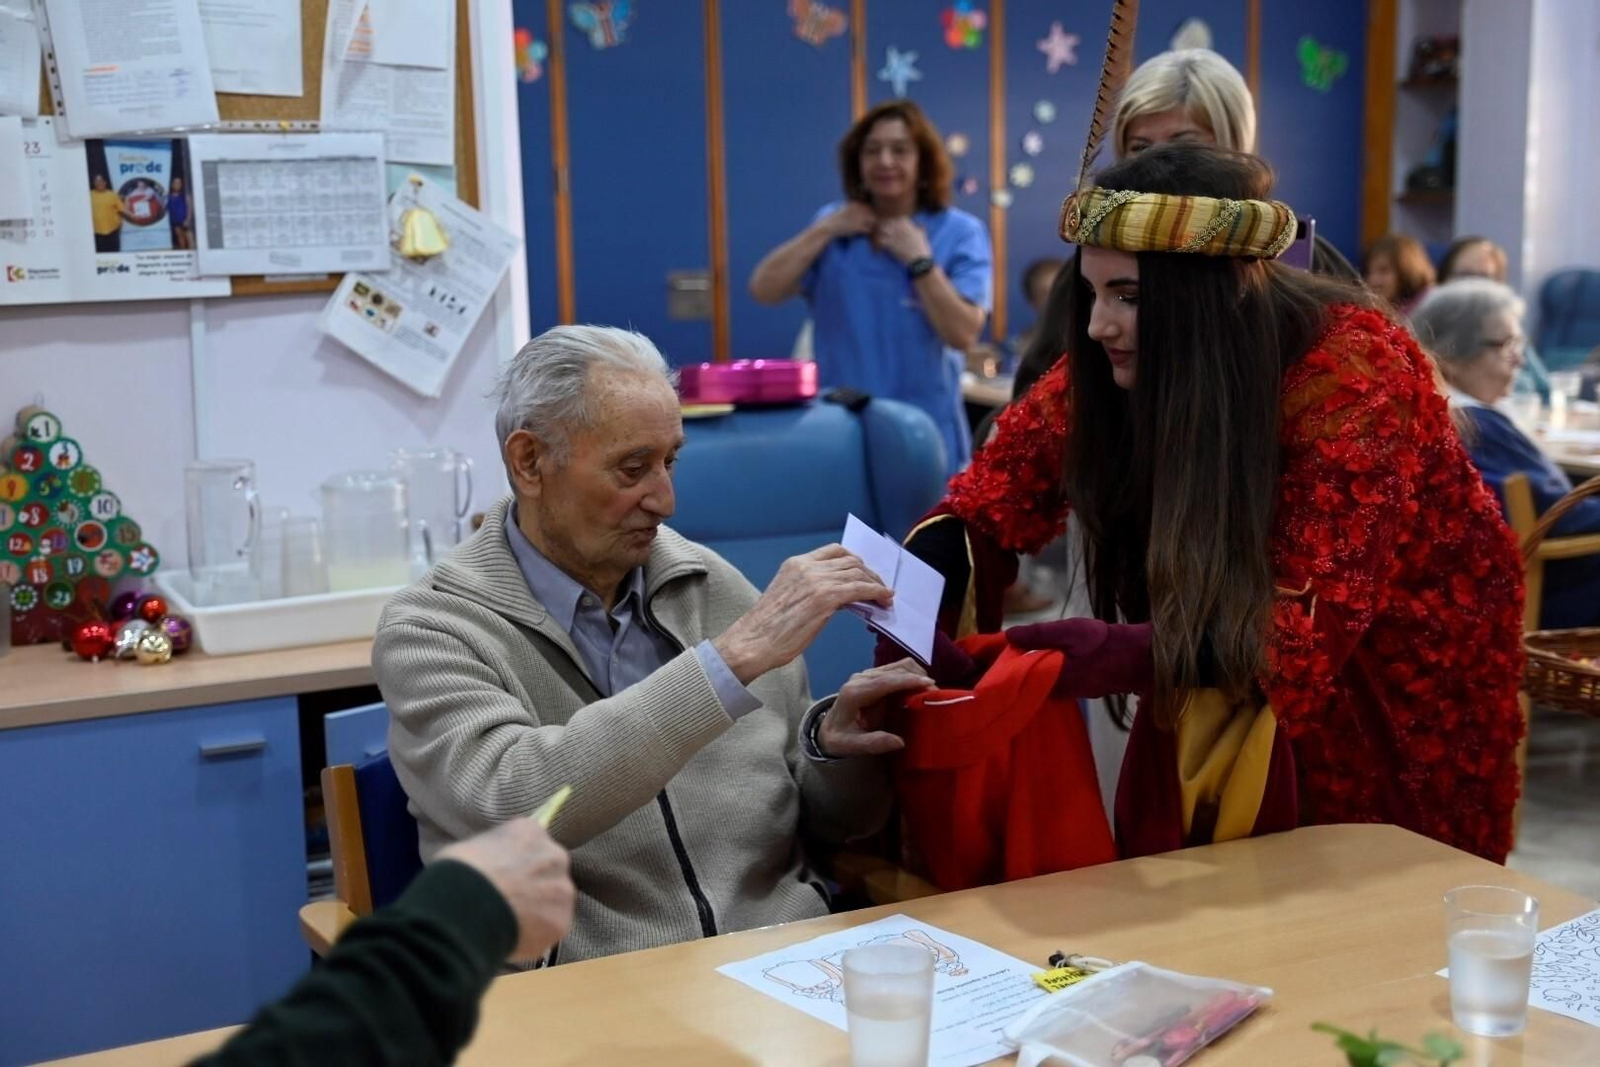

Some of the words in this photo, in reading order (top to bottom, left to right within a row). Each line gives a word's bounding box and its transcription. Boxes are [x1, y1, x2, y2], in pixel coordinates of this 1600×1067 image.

[21, 453, 34, 471] 2
[97, 499, 113, 514] 10
[31, 506, 40, 526] 8
[67, 557, 83, 574] 19
